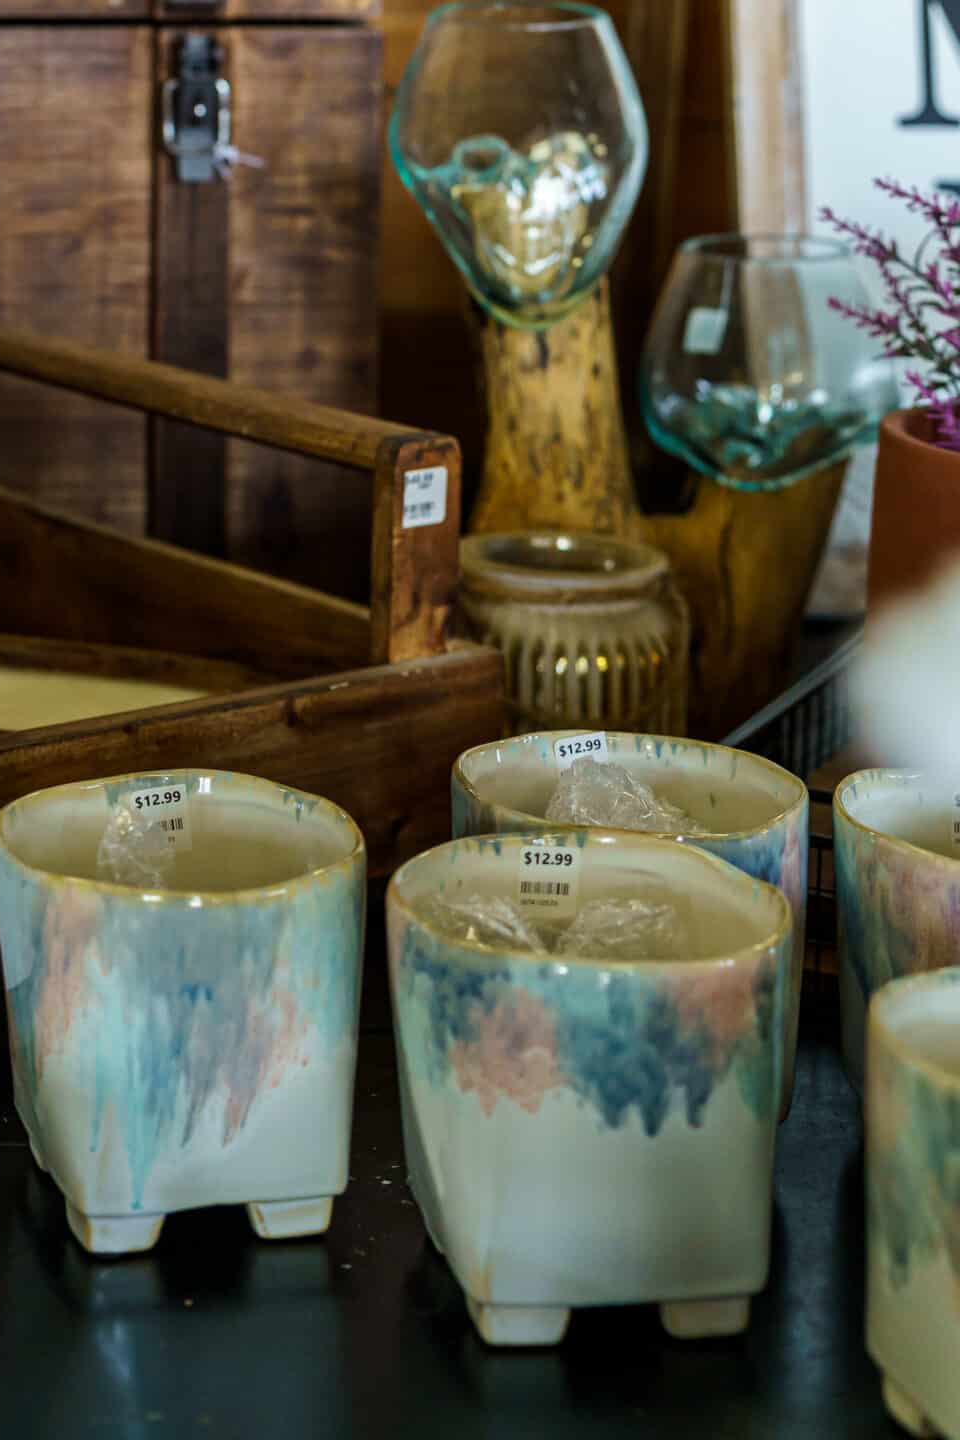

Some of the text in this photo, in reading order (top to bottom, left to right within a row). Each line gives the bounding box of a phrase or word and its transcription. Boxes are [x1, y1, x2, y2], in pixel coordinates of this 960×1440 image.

[559, 739, 601, 757] $12.99
[135, 791, 181, 809] $12.99
[524, 852, 573, 866] $12.99
